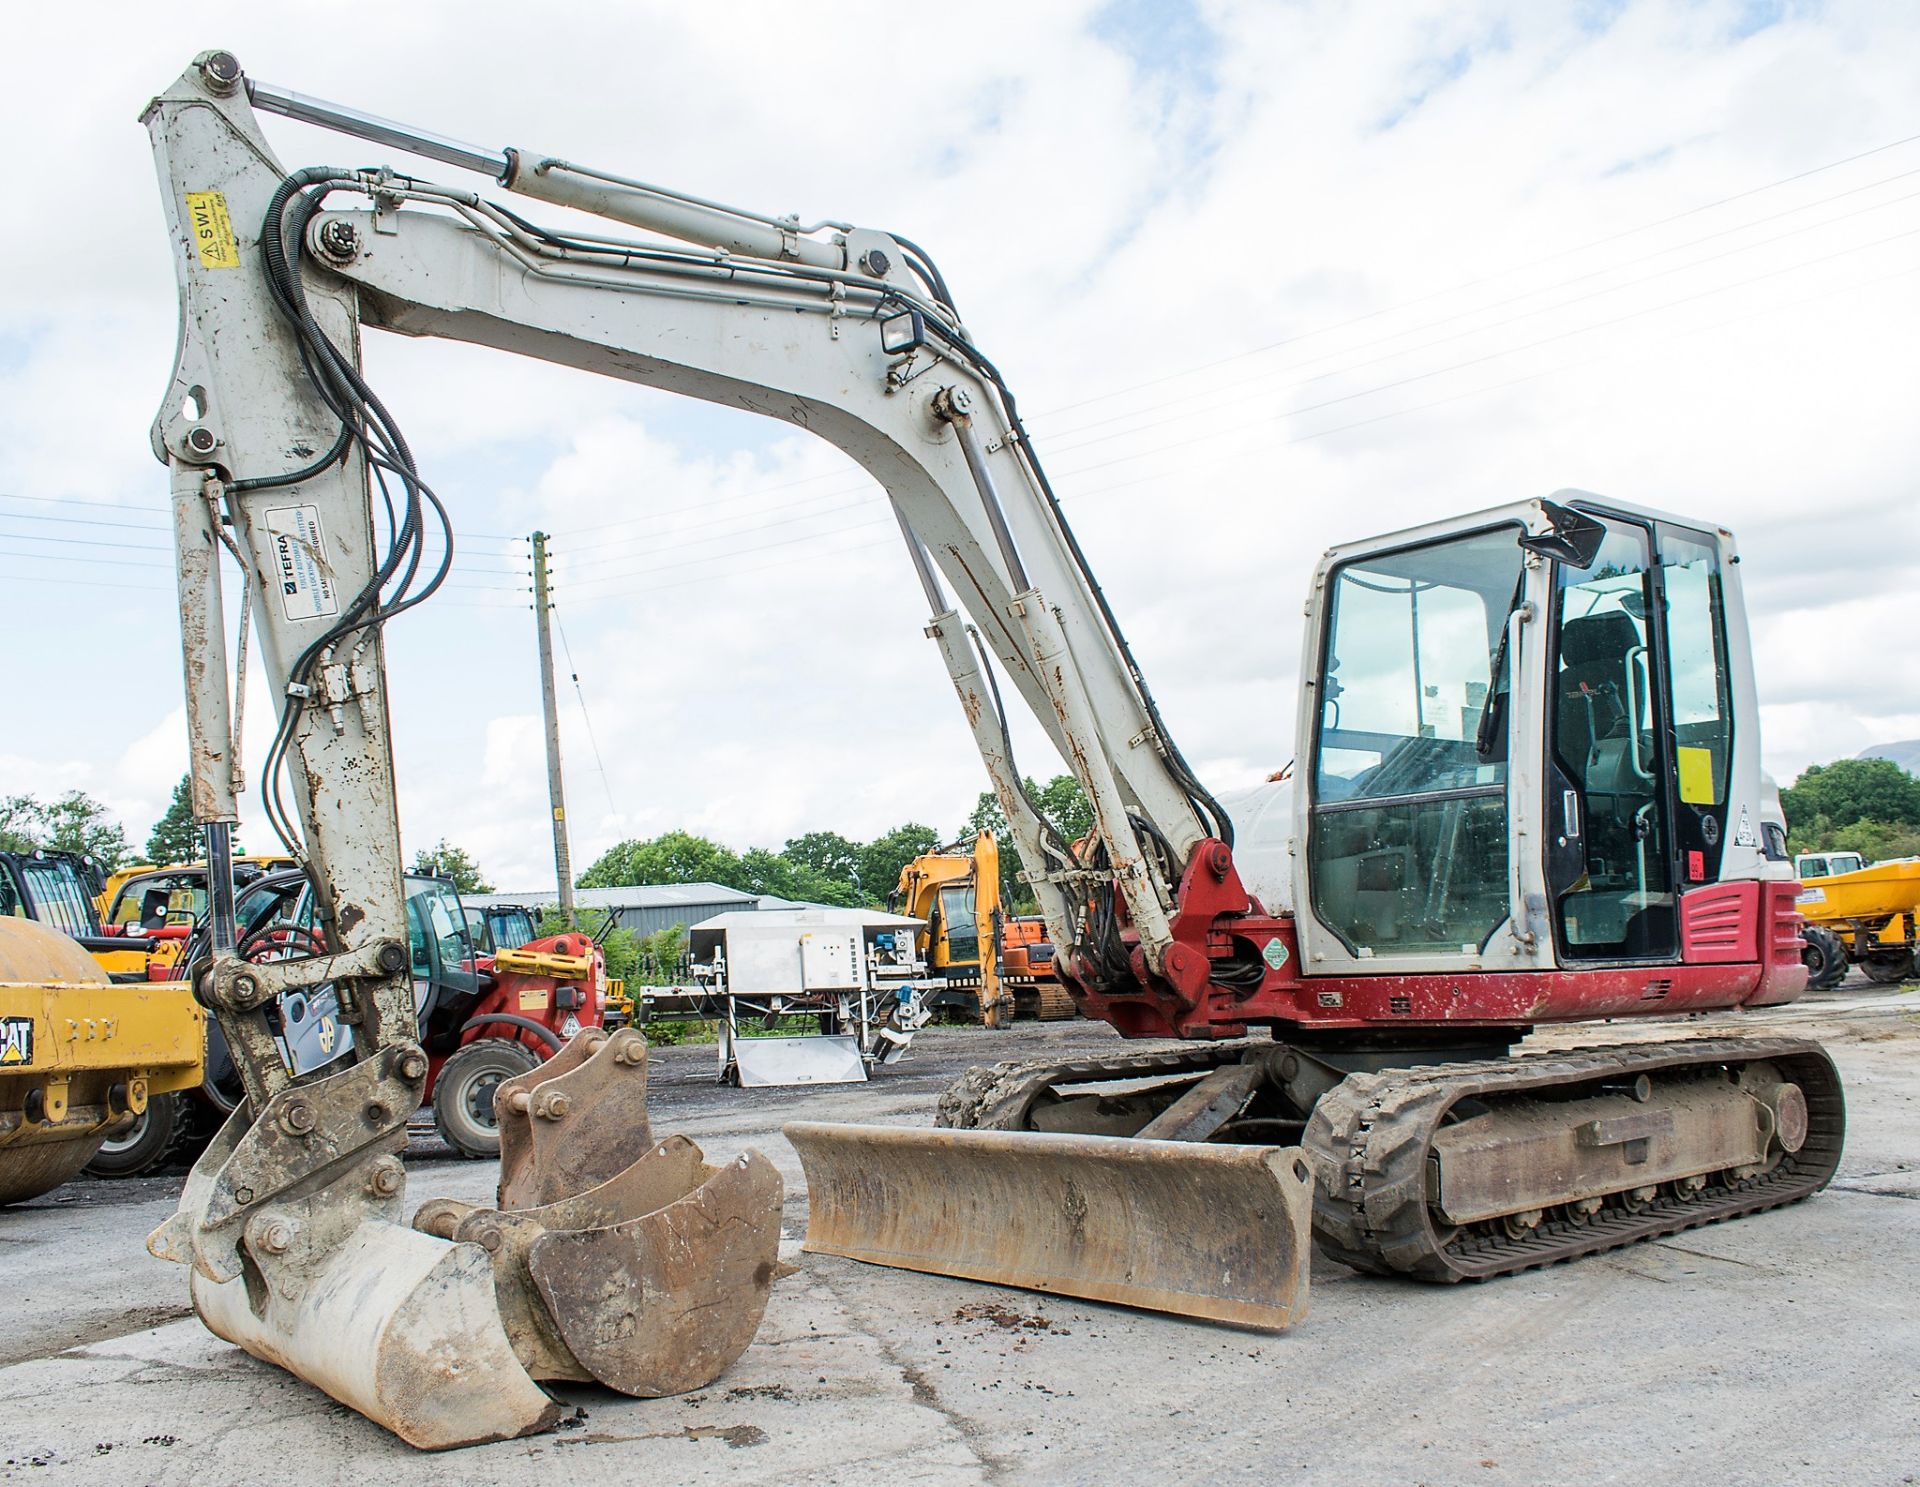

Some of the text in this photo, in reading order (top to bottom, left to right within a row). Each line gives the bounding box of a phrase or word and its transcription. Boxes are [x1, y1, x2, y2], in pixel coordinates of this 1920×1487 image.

[194, 200, 213, 238] SWL
[277, 534, 293, 580] TEFRA
[322, 590, 330, 598] NO
